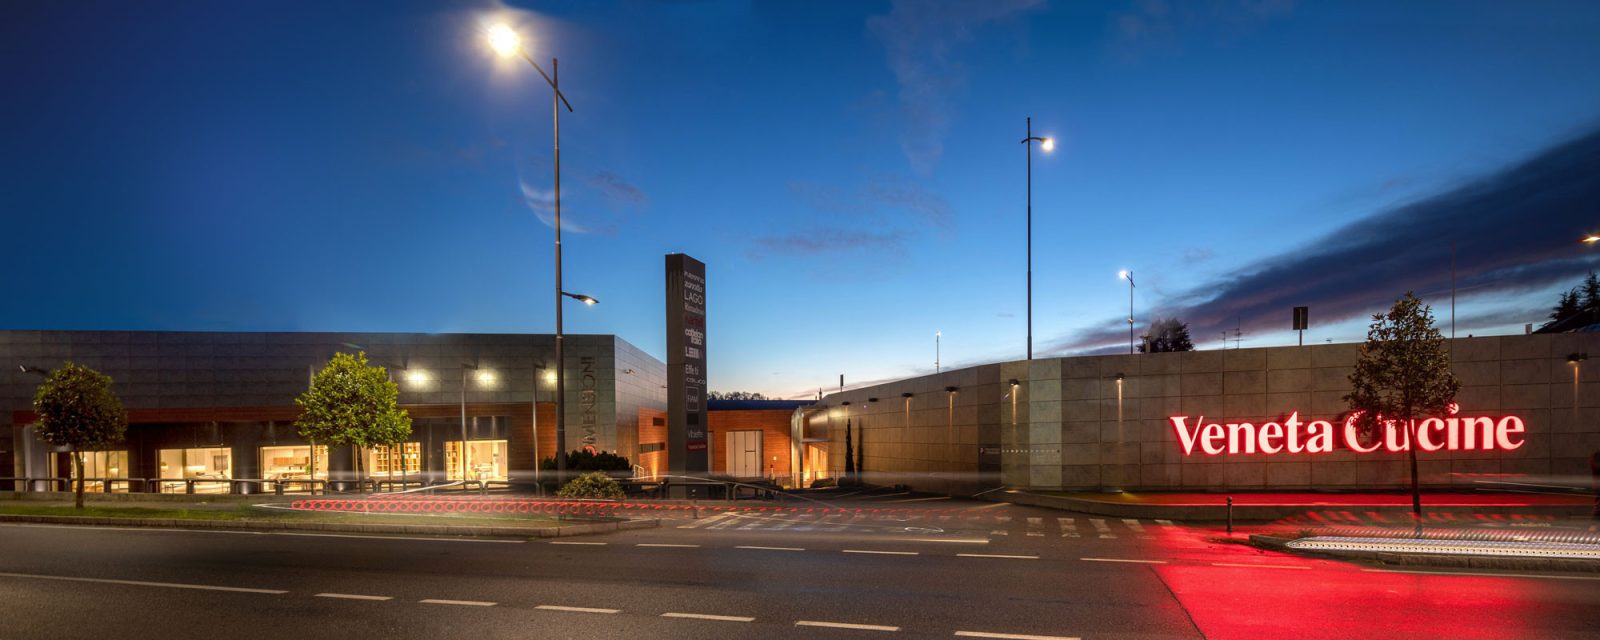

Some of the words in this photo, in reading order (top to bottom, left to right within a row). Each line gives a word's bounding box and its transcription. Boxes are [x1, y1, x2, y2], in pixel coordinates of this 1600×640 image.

[684, 288, 703, 305] LAGO
[1170, 410, 1333, 456] Veneta
[1344, 402, 1525, 453] Cucine
